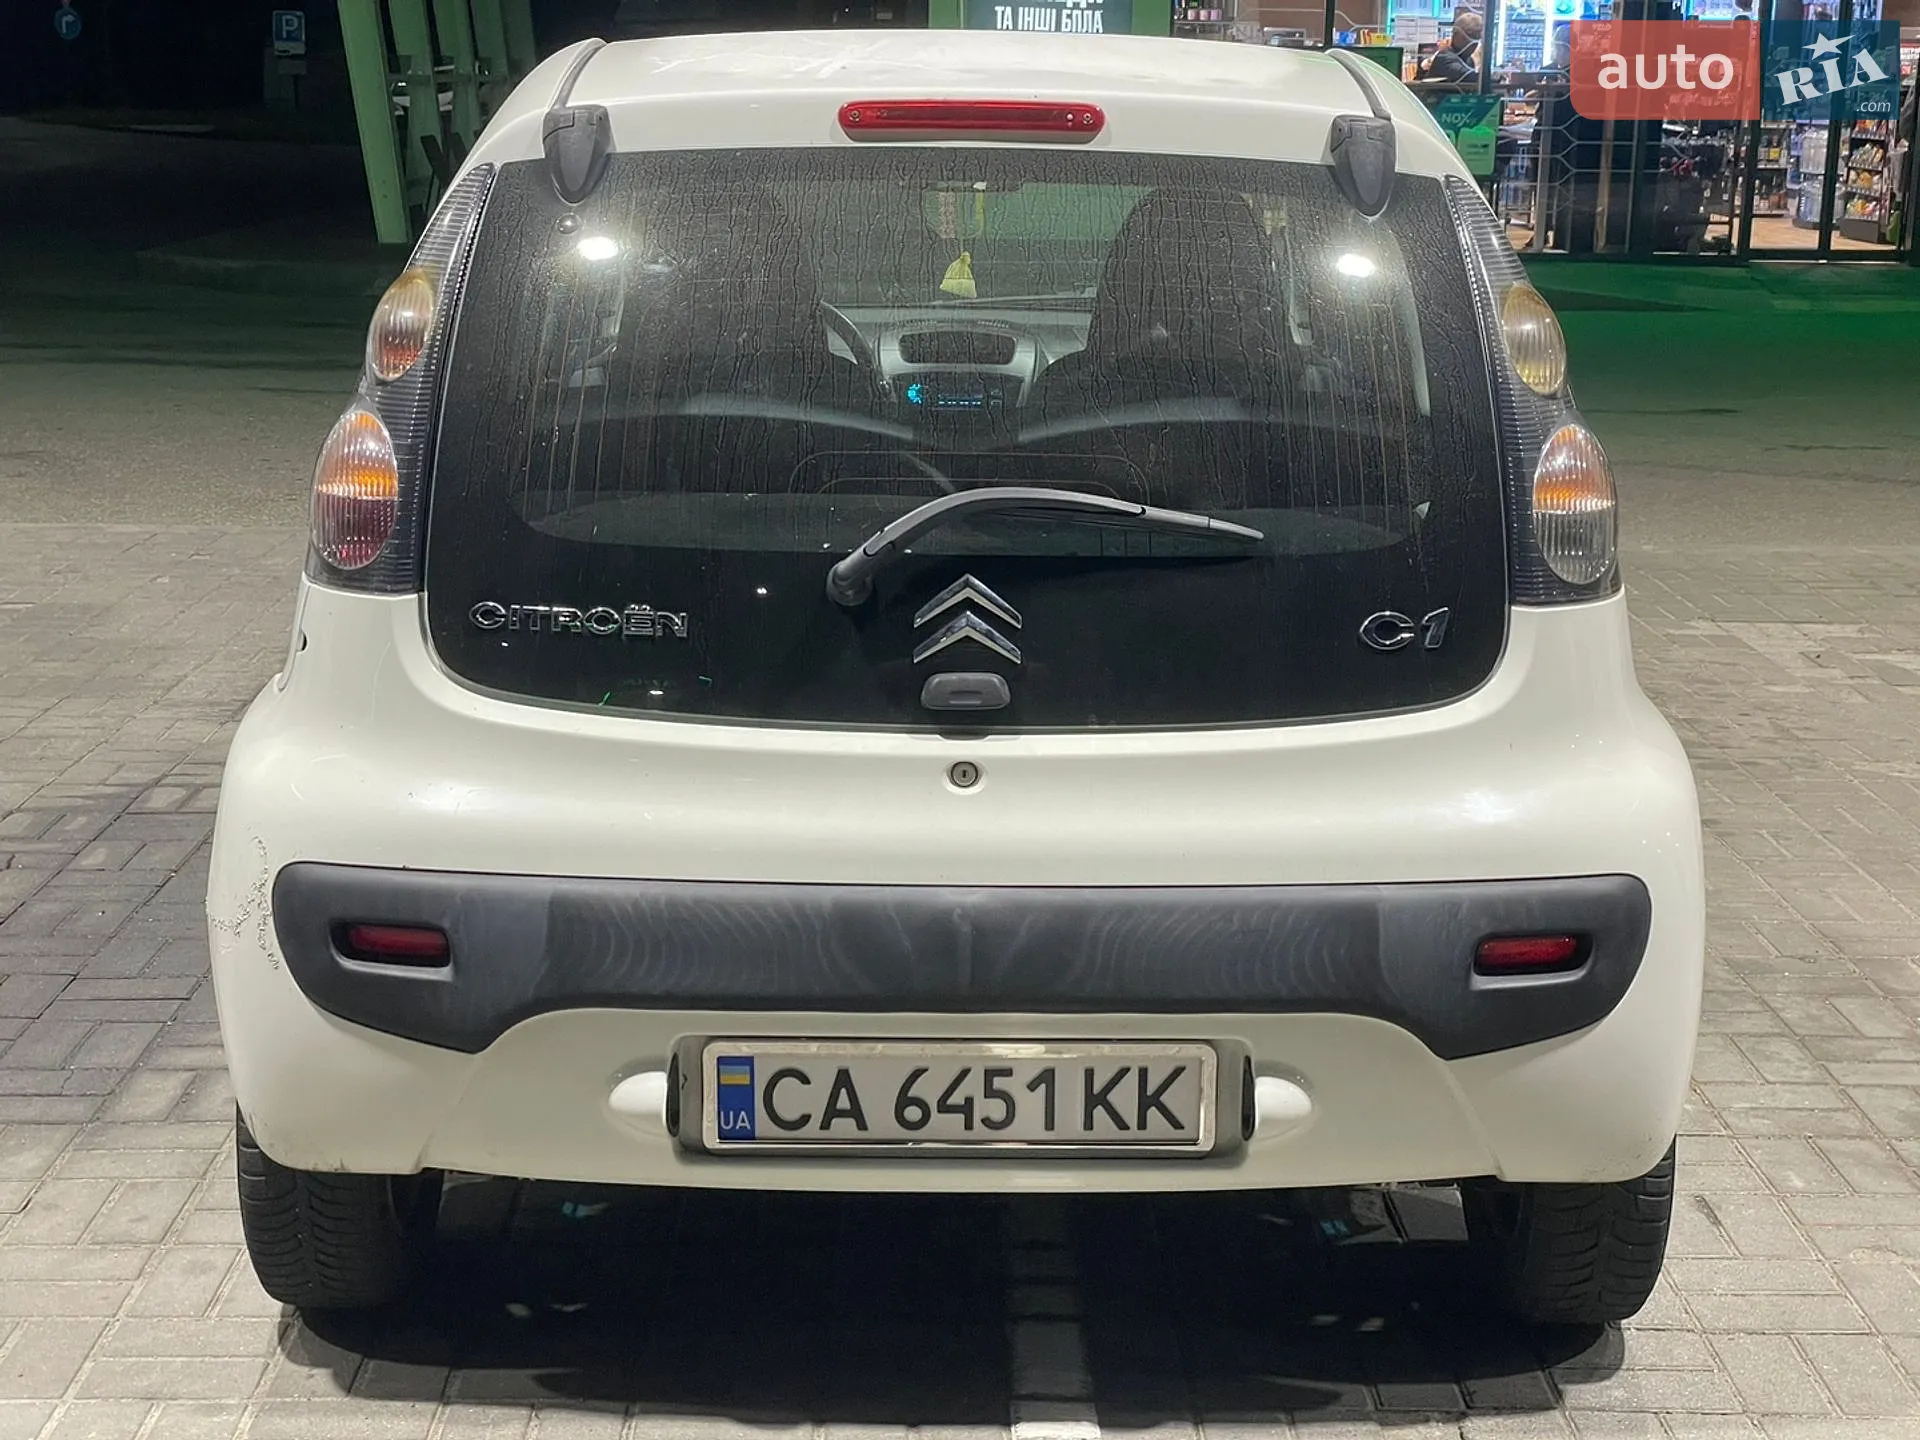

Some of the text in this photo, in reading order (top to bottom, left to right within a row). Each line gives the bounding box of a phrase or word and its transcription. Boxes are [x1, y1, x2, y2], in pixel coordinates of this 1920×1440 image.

[282, 14, 299, 39] P
[994, 6, 1104, 34] ТА ІНШІ БПЛА
[468, 600, 690, 639] CITROËN
[1359, 606, 1450, 651] C1
[762, 1065, 1188, 1133] CA 6451 KK
[718, 1110, 752, 1132] UA
